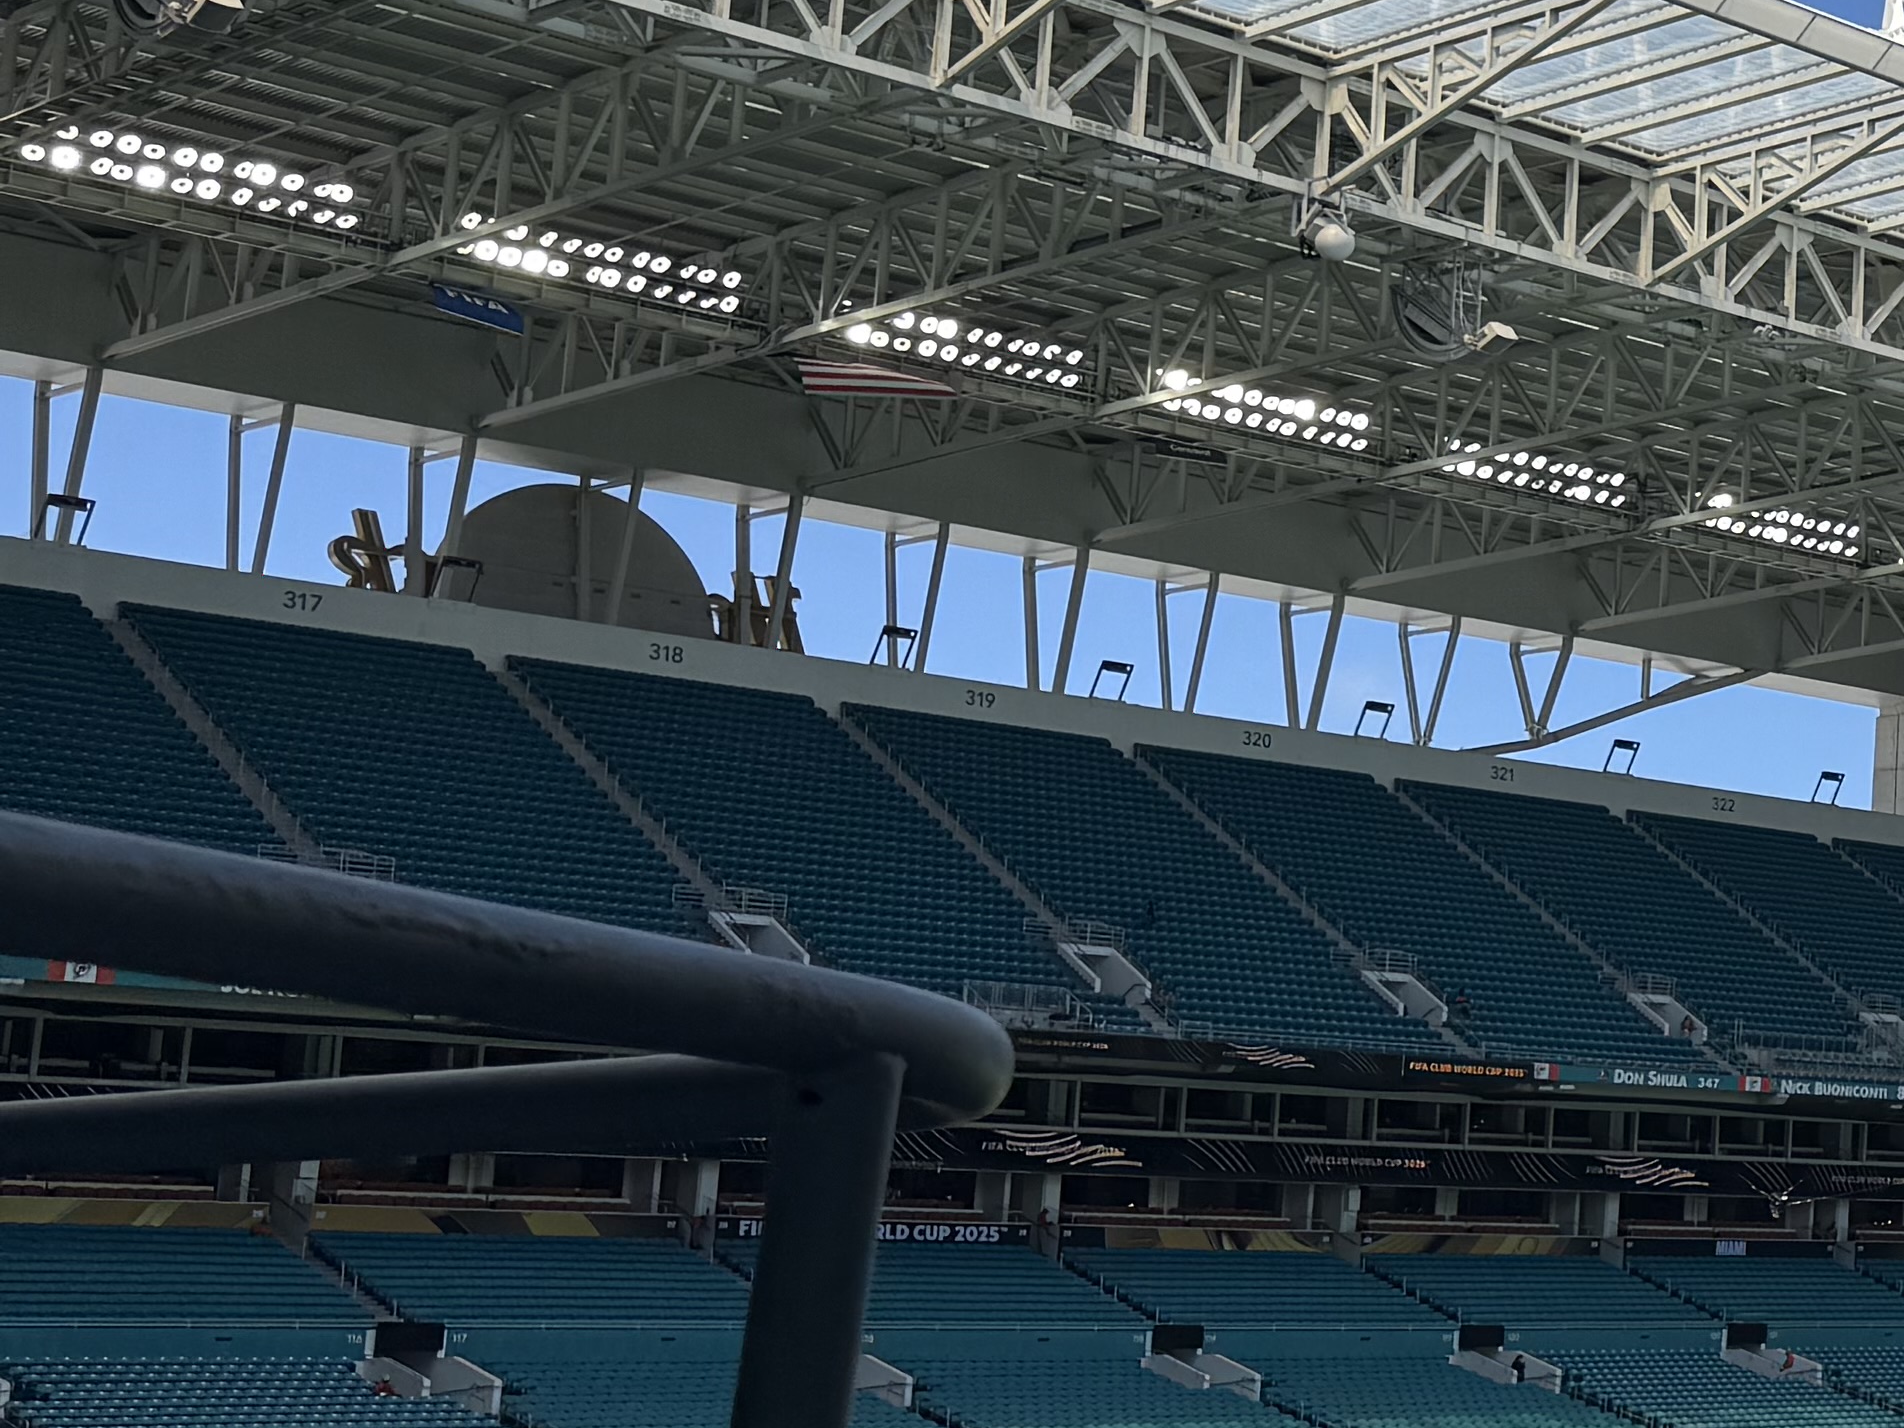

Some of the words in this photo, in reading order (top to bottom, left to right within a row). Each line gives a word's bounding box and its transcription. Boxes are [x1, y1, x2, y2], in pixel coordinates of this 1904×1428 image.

[283, 590, 323, 612] 317
[649, 643, 683, 663] 318
[965, 690, 996, 708] 319
[1242, 731, 1272, 748] 320
[1490, 766, 1514, 781] 321
[1712, 797, 1735, 812] 322
[1613, 1069, 1644, 1085] DON
[1648, 1071, 1687, 1088] SHULA
[1698, 1078, 1720, 1090] 347
[913, 1225, 950, 1241] CUP
[1715, 1241, 1746, 1256] MIAMI
